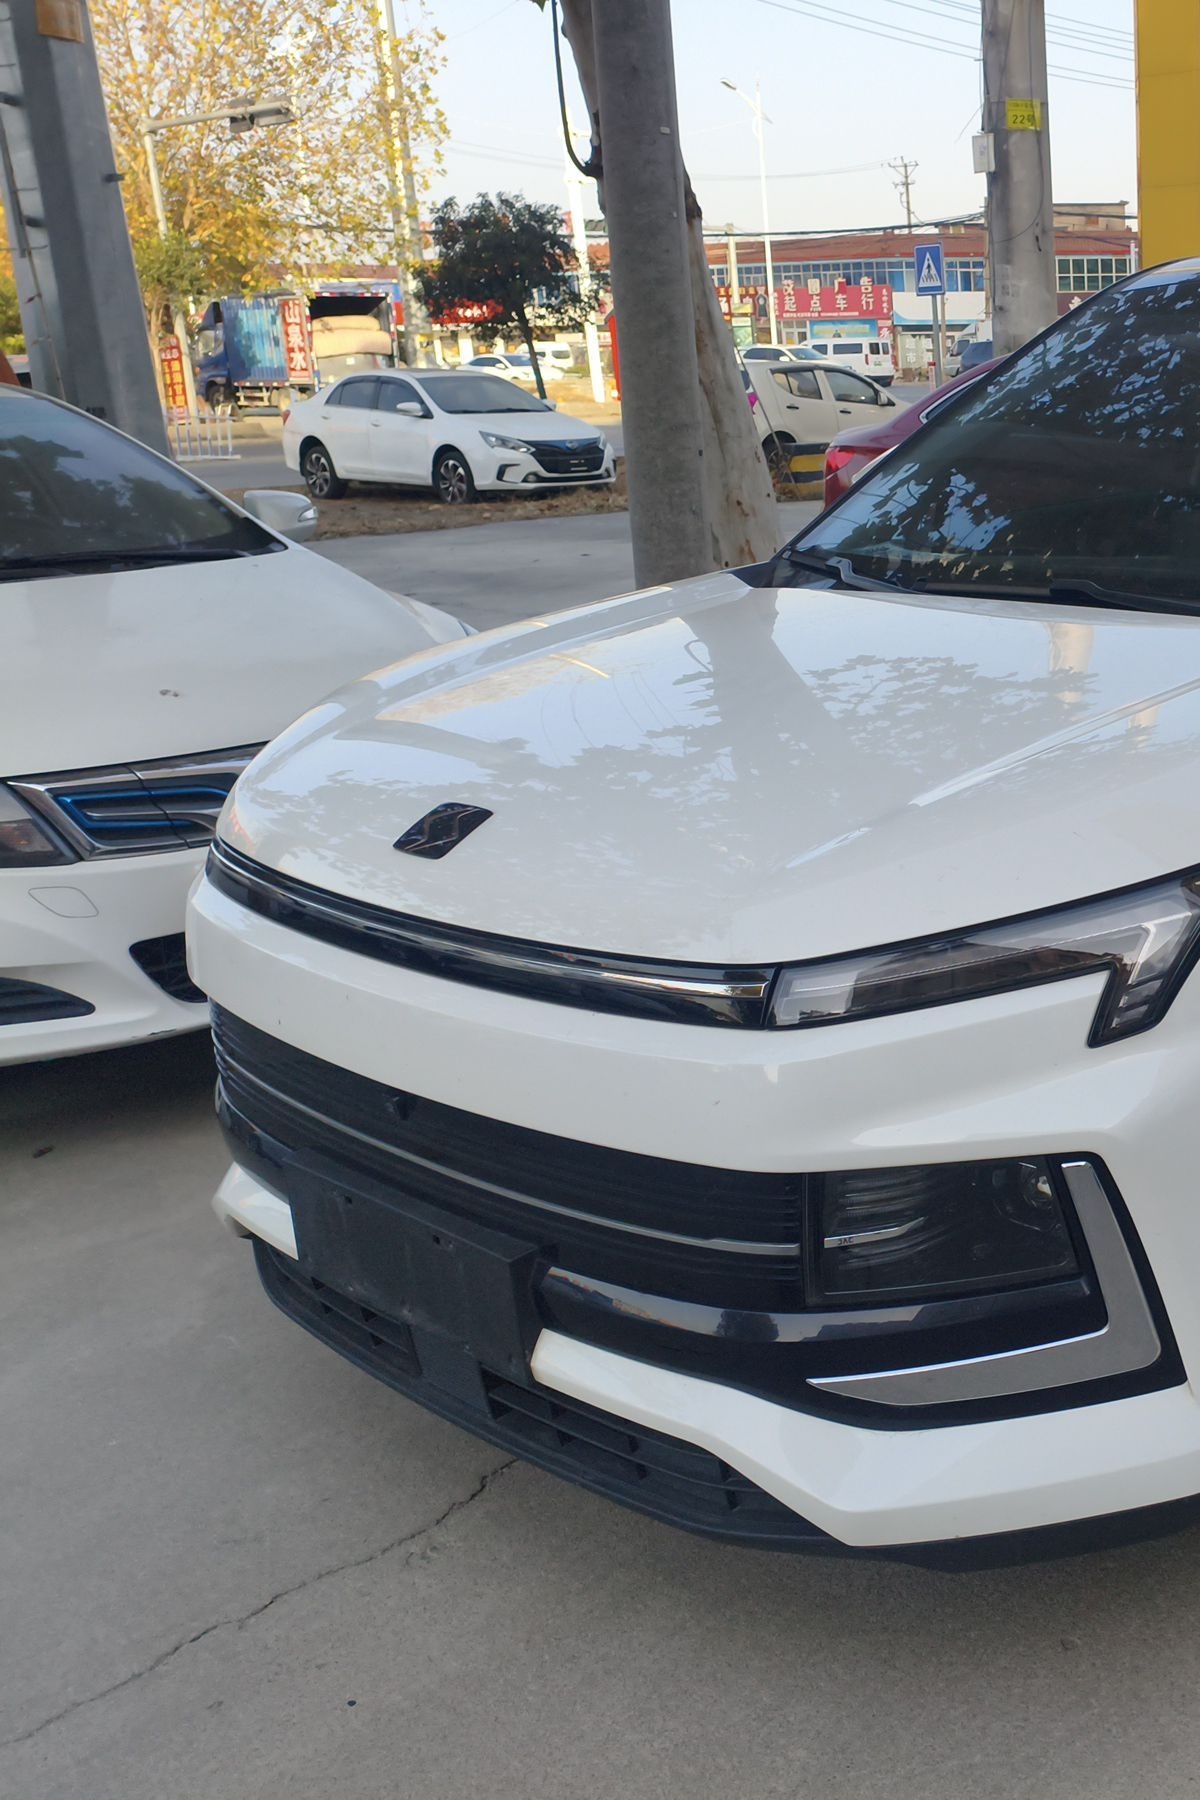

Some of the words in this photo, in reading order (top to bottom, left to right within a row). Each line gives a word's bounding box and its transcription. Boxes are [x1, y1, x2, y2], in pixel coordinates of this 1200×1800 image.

[783, 294, 875, 313] 起点车行
[284, 300, 308, 371] 山泉水
